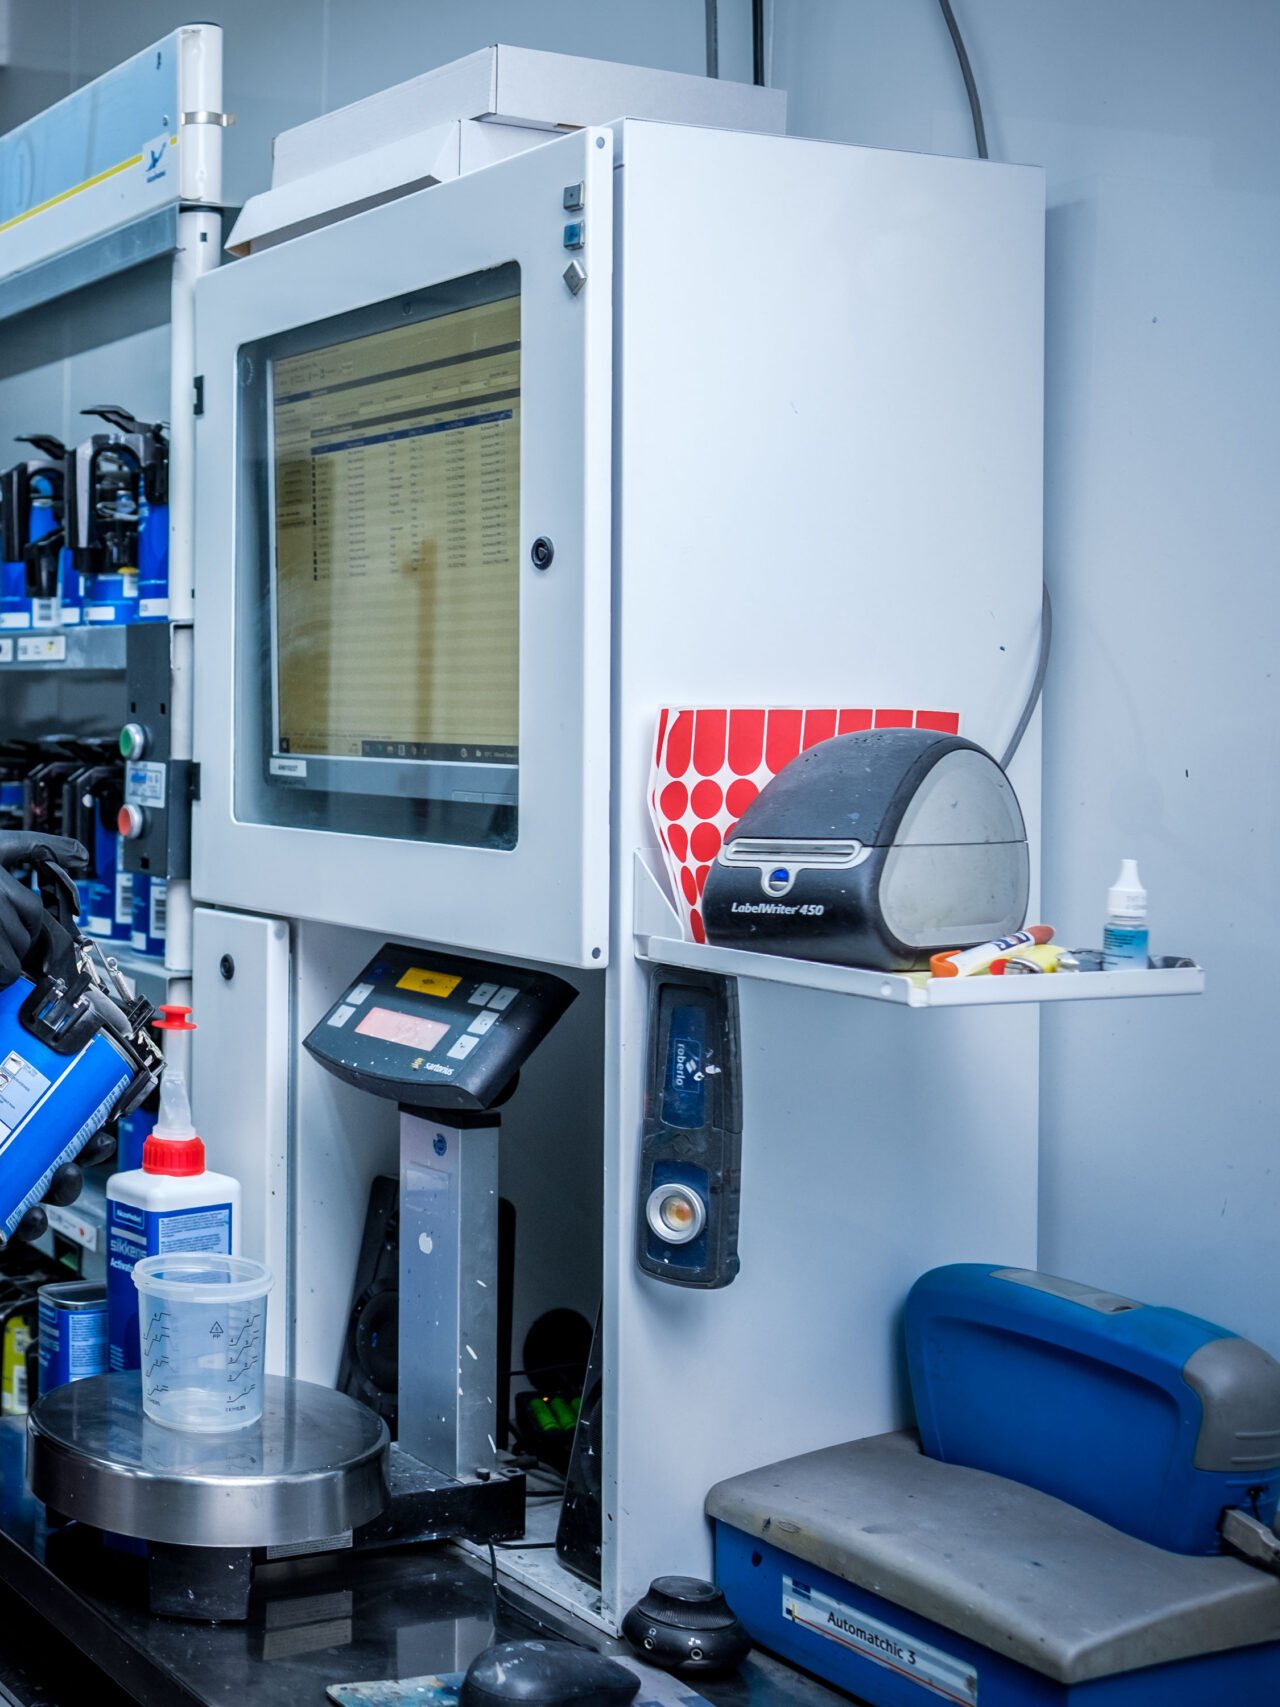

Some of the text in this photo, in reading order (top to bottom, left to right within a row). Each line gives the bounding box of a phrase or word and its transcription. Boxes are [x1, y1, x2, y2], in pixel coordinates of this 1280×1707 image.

[731, 902, 825, 916] LabelWriter 450
[675, 1043, 686, 1086] roberlo
[110, 1239, 147, 1260] sikkens
[110, 1258, 135, 1273] Activato
[827, 1610, 917, 1666] Automatchic 3
